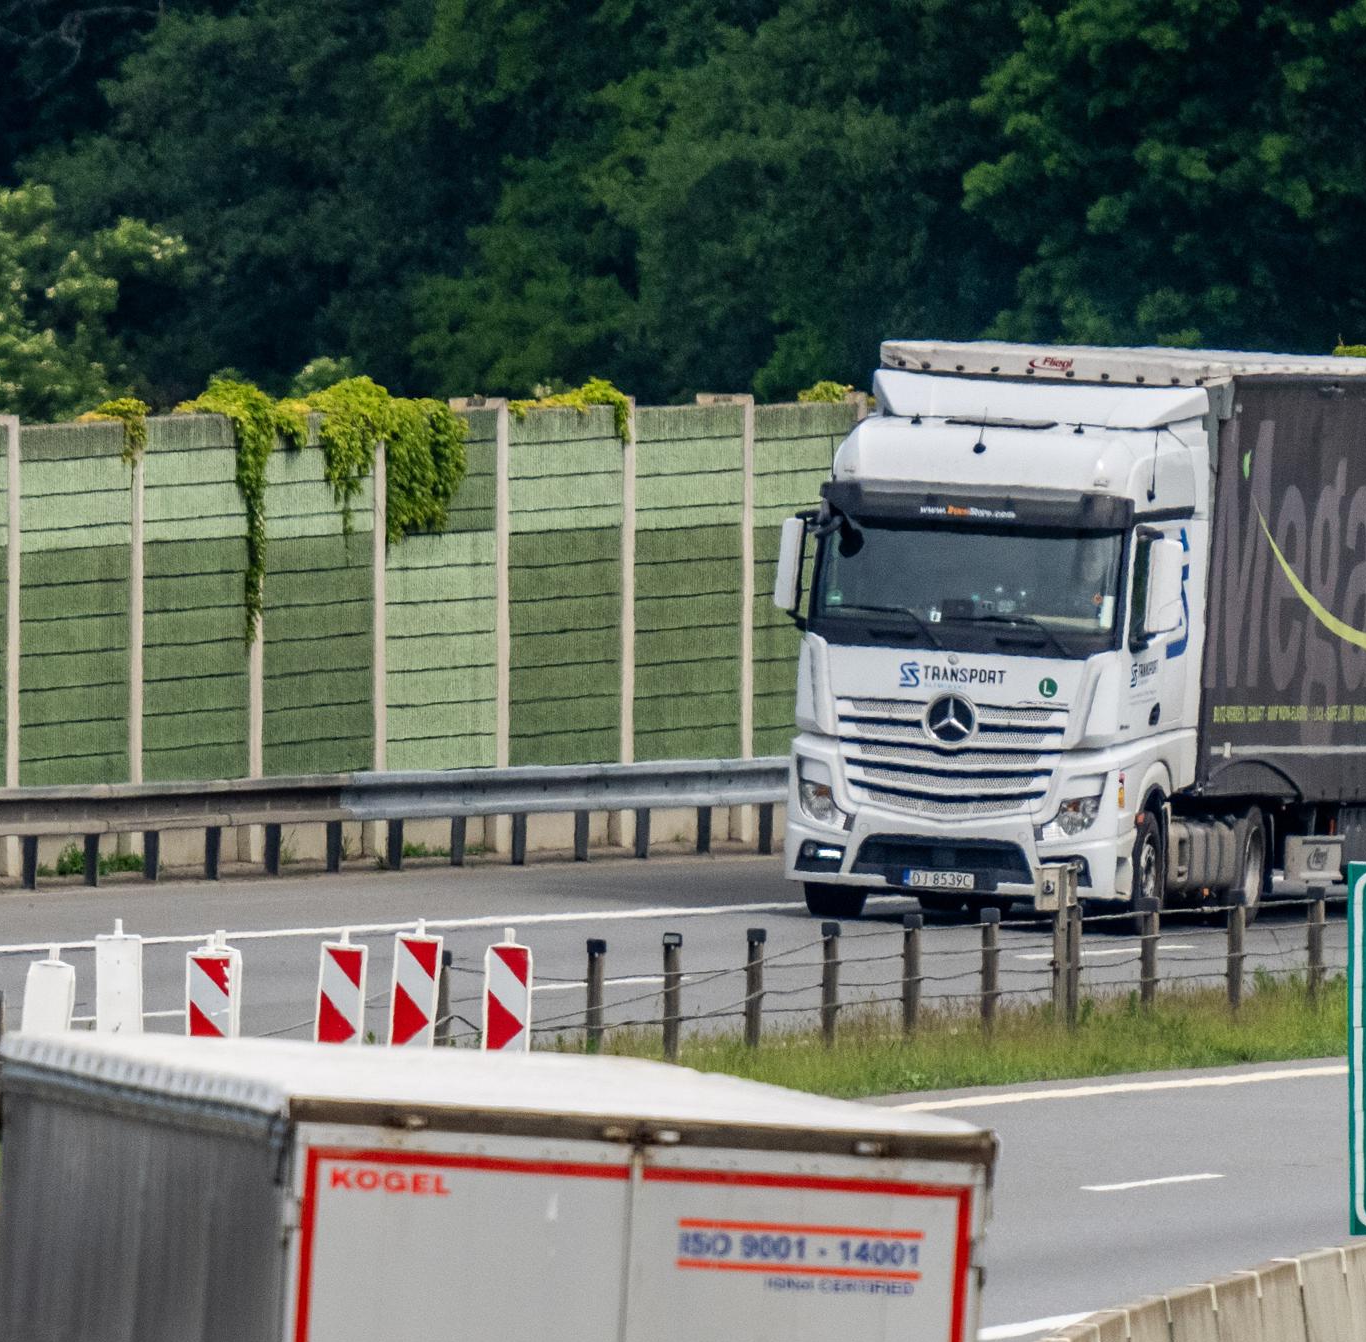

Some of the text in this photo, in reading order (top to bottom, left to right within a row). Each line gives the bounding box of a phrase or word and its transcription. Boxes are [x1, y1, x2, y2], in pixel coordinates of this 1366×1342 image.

[1042, 357, 1074, 372] Fliegl
[923, 665, 1007, 685] TRANSPORT
[1043, 680, 1053, 697] L
[678, 1231, 733, 1257] ISO
[739, 1234, 807, 1260] 9001
[837, 1239, 921, 1266] 14001
